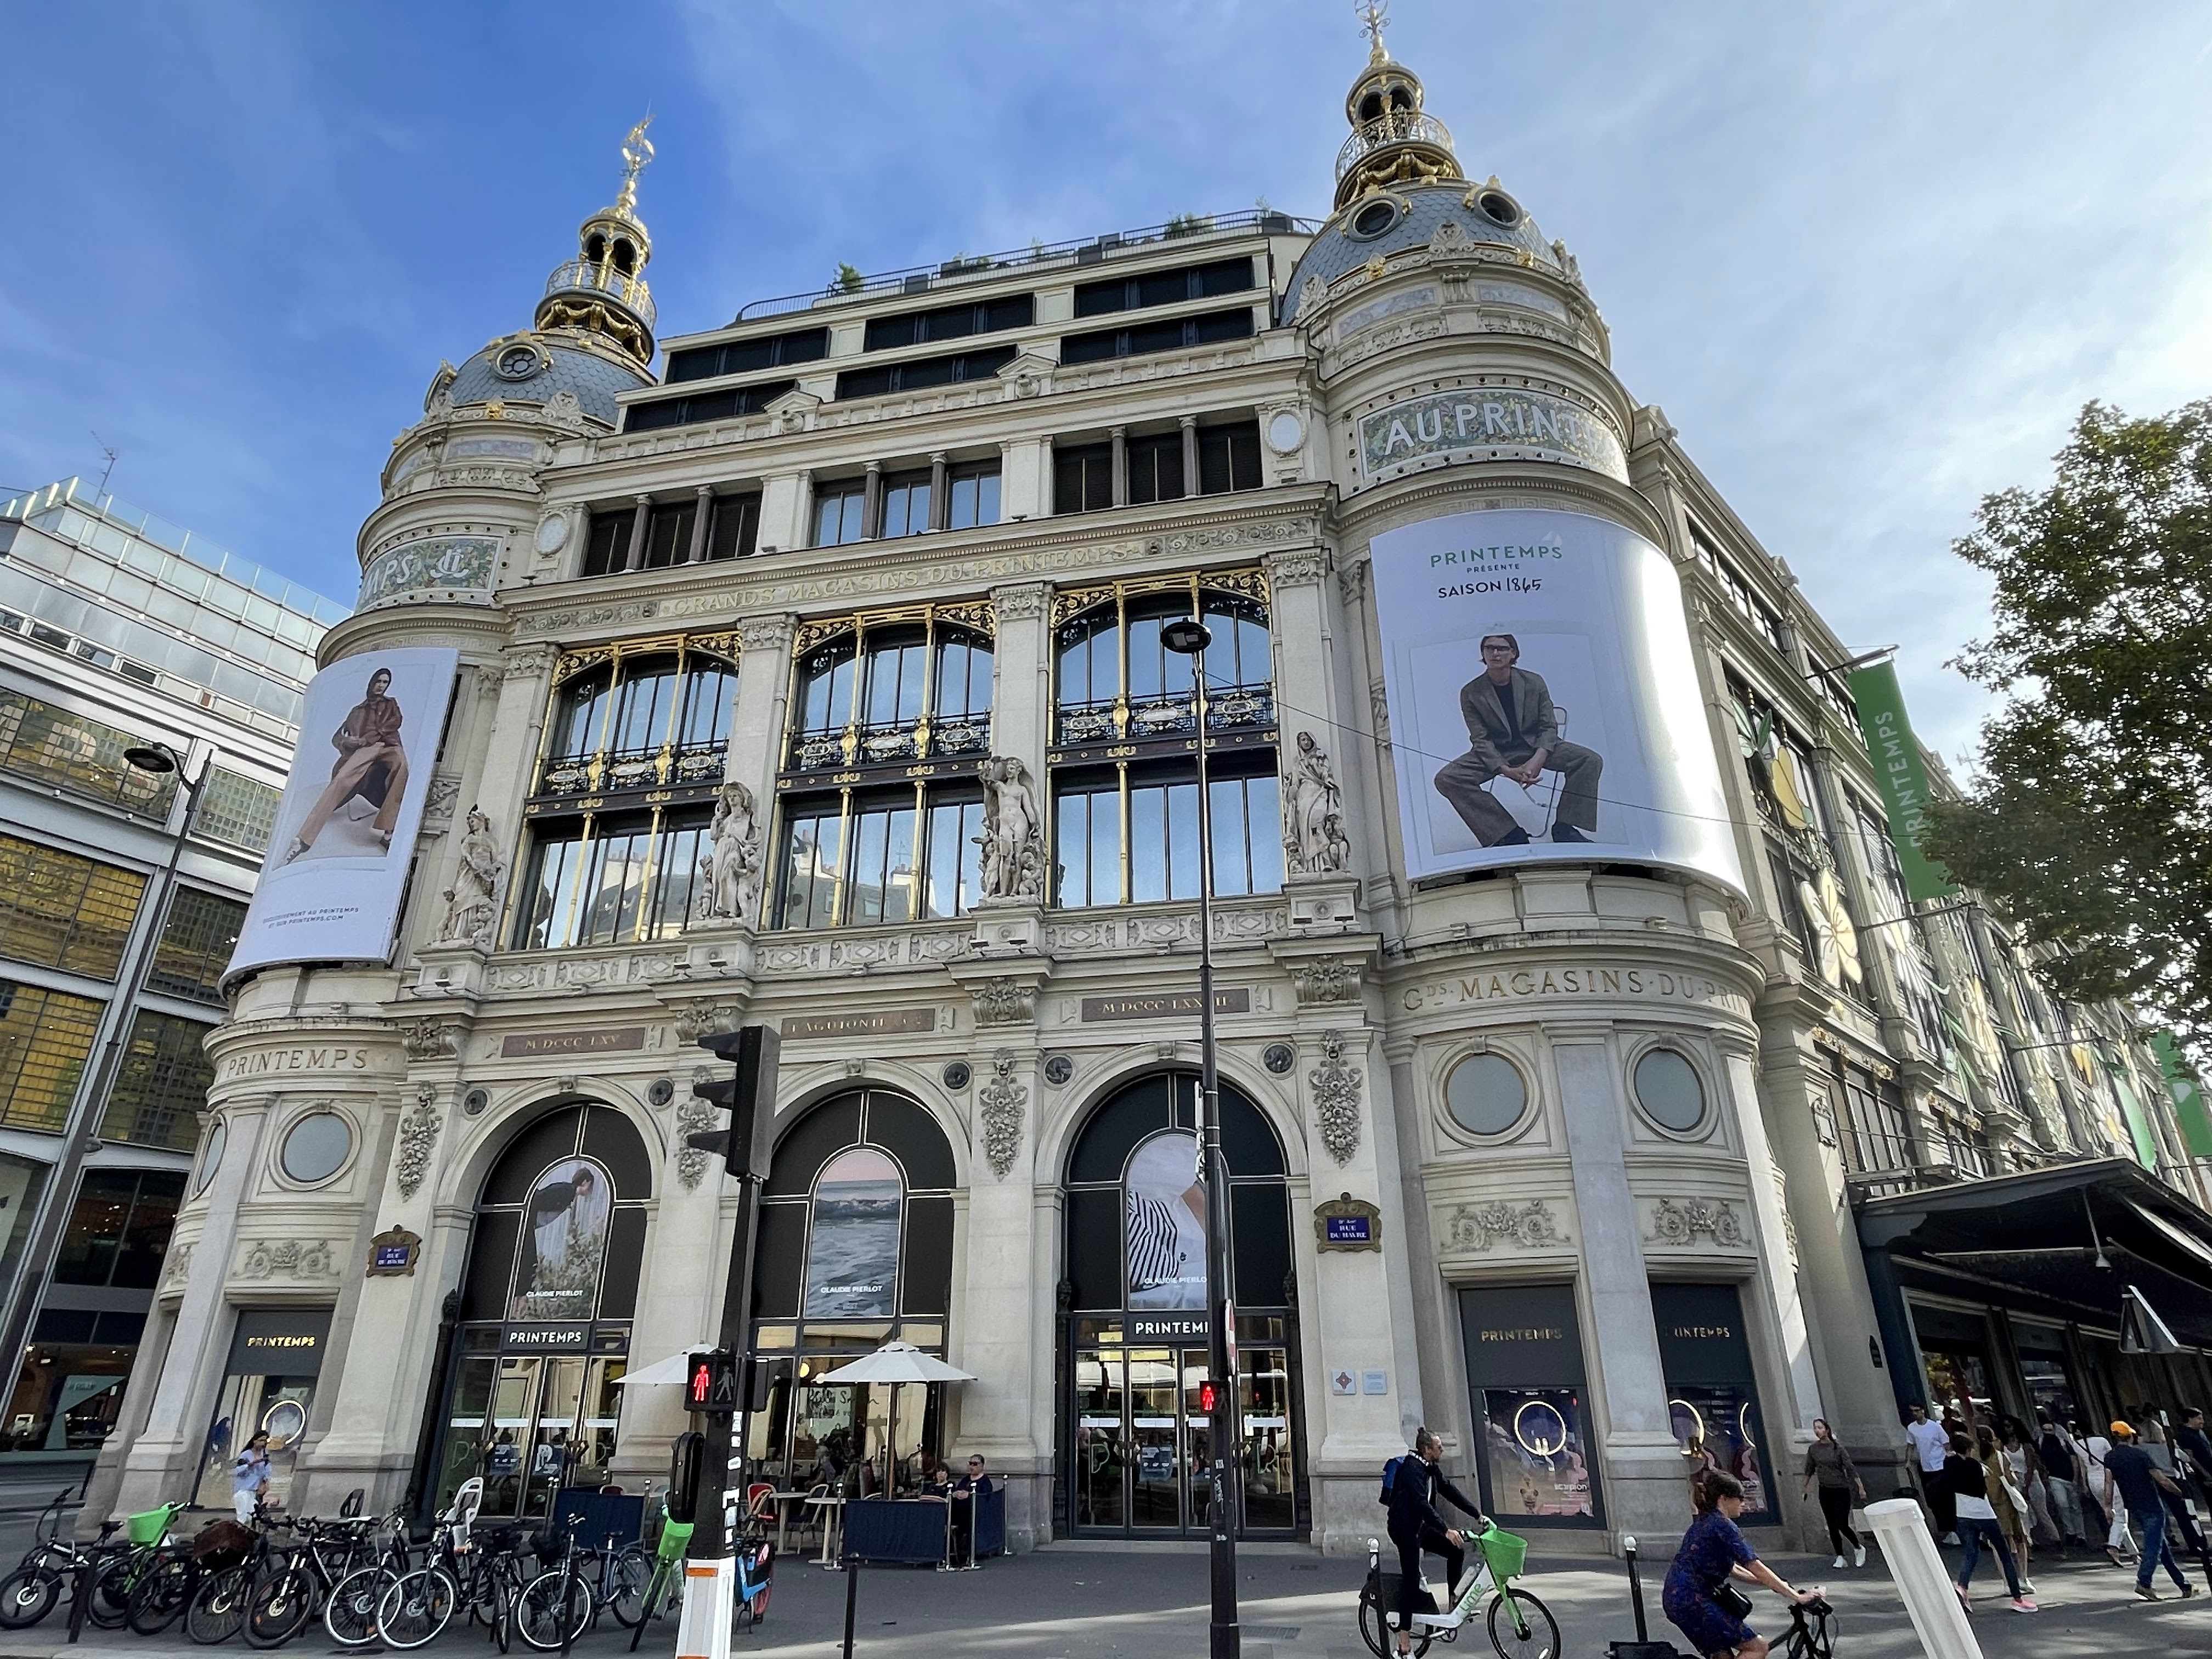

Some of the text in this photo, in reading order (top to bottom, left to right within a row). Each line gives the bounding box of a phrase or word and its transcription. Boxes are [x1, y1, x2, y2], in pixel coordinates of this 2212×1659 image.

[1385, 403, 1594, 455] AU PRINT
[1430, 545, 1562, 567] PRINTEMPS
[675, 543, 1128, 615] GRANDS MAGASINS DU PRINTEMPS
[1466, 563, 1520, 573] PRÉSENTE
[1438, 577, 1542, 598] SAISON 1865
[1458, 969, 1644, 1002] MAGASINS
[1658, 973, 1694, 999] DU
[225, 1048, 368, 1078] PRINTEMPS
[247, 1336, 315, 1347] PRINTEMPS
[509, 1331, 582, 1343] PRINTEMPS
[1481, 1327, 1563, 1342] PRINTEMPS
[1459, 1583, 1483, 1611] Lime
